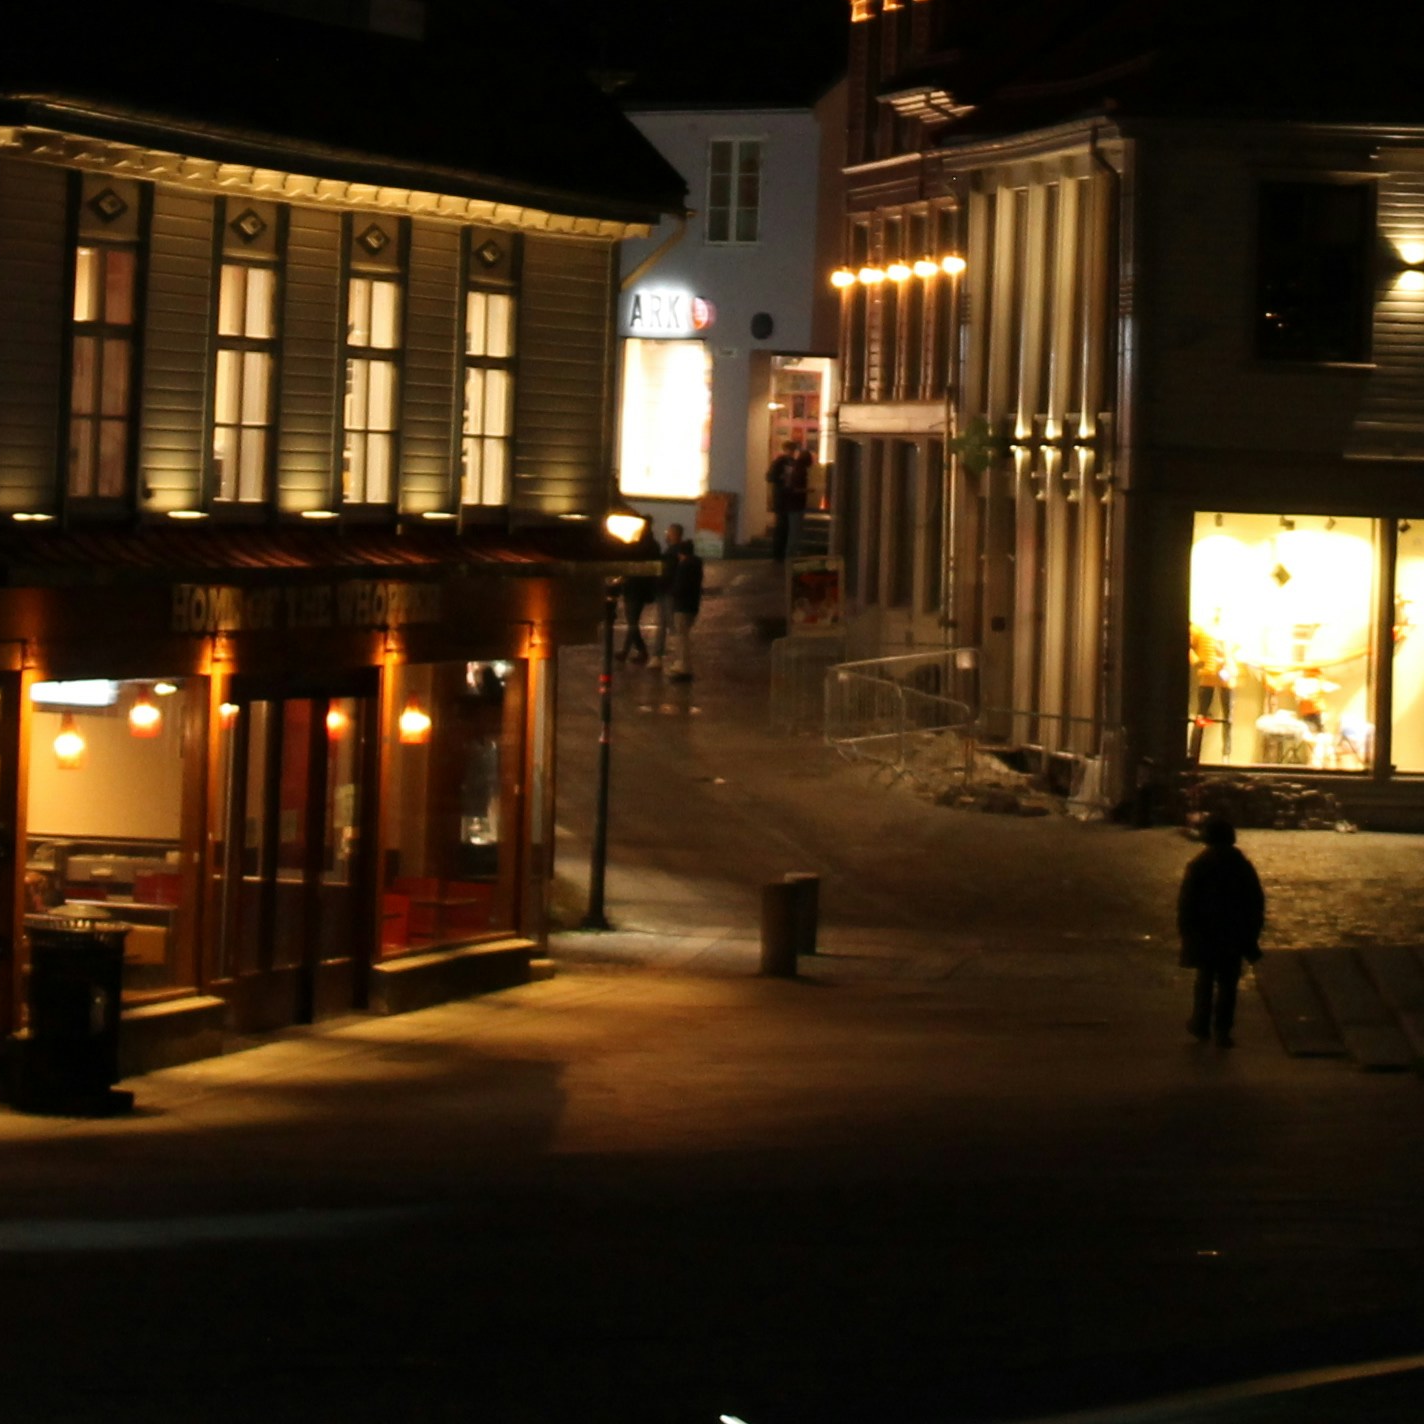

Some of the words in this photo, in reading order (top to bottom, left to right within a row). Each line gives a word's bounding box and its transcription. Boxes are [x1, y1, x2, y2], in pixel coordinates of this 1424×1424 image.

[629, 293, 681, 329] ARK
[170, 582, 243, 632] HOME
[285, 584, 332, 628] THE
